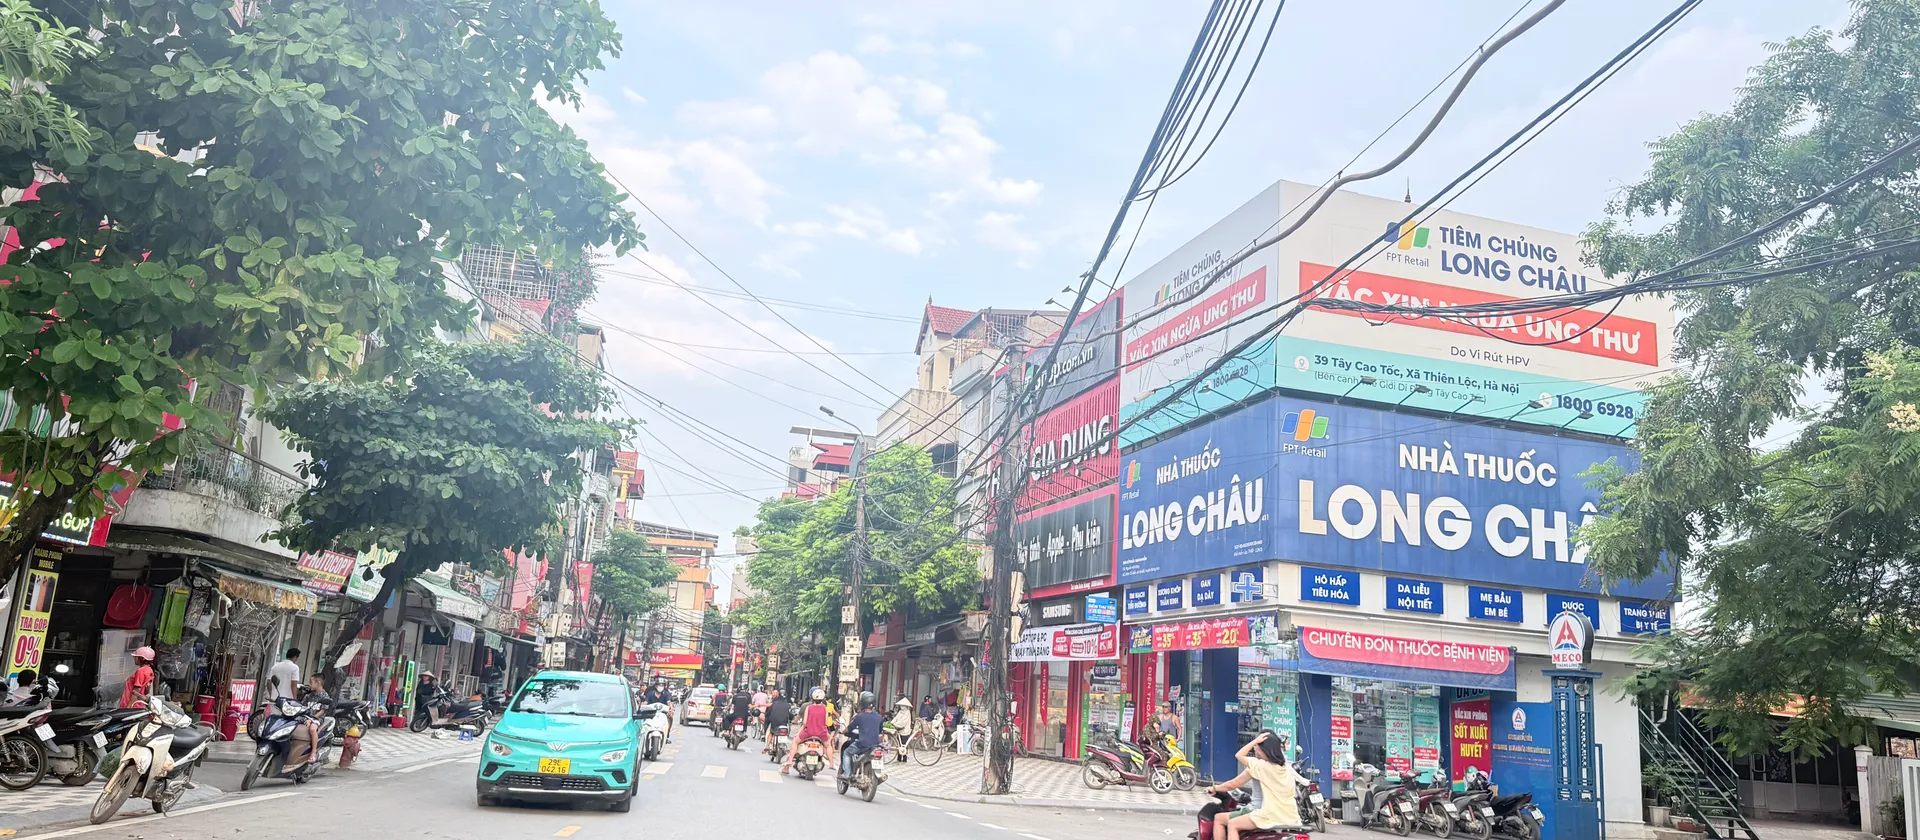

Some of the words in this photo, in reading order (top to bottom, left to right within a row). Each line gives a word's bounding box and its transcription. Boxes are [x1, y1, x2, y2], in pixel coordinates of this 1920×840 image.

[1439, 225, 1481, 249] TIÊM
[1487, 236, 1557, 263] CHỦNG
[1386, 252, 1402, 263] FPT
[1404, 255, 1429, 267] Retail
[1173, 270, 1190, 289] TIÊM
[1191, 250, 1221, 277] CHỦNG
[1441, 250, 1511, 281] LONG
[1518, 265, 1586, 294] CHÂU
[1151, 332, 1169, 352] XIN
[1170, 315, 1201, 343] NGỪA
[1203, 300, 1228, 327] UNG
[1230, 280, 1258, 311] THƯ
[1590, 327, 1641, 354] THƯ
[1450, 346, 1466, 357] Do
[1469, 348, 1480, 359] Vi
[1484, 351, 1503, 363] Rút
[1506, 355, 1530, 367] HPV
[1314, 355, 1329, 365] 39
[1332, 357, 1352, 371] Tây
[1355, 361, 1377, 373] Cao
[1379, 362, 1403, 379] Tốc,
[1406, 368, 1421, 379] Xã
[1424, 370, 1455, 384] Thiên
[1458, 375, 1480, 390] Lộc,
[1483, 379, 1498, 390] Hà
[1501, 383, 1520, 395] Nội
[1314, 371, 1334, 381] (Bên
[1336, 373, 1359, 385] cạnh
[1435, 388, 1449, 399] Tây
[1452, 391, 1467, 401] Cao
[1556, 394, 1592, 413] 1800
[1597, 402, 1634, 419] 6928
[1061, 415, 1112, 476] DỤNG
[1283, 443, 1299, 455] FPT
[1301, 445, 1327, 458] Retail
[1156, 455, 1179, 485] NHÀ
[1181, 437, 1220, 477] THUỐC
[1399, 440, 1460, 476] NHÀ
[1464, 448, 1557, 487] THUỐC
[1121, 492, 1129, 501] FPT
[1129, 489, 1139, 499] Retail
[1122, 501, 1183, 550] LONG
[1187, 474, 1263, 536] CHÂU
[1298, 479, 1472, 551] LONG
[1046, 529, 1065, 563] Apple
[1071, 523, 1084, 558] Phụ
[1086, 519, 1100, 554] kiện
[39, 560, 55, 569] MOBILE
[1200, 579, 1211, 588] GAN
[1315, 575, 1327, 585] HÔ
[1329, 575, 1347, 586] HẤP
[1170, 585, 1182, 594] KHỚP
[1312, 587, 1328, 598] TIÊU
[1331, 588, 1349, 600] HÓA
[1398, 584, 1412, 594] DA
[1415, 583, 1430, 595] LIỄU
[1398, 599, 1414, 609] NỘI
[1416, 598, 1433, 609] TIẾT
[1480, 593, 1493, 603] MẸ
[1495, 590, 1511, 604] BẦU
[1042, 603, 1072, 619] SAMSUNG
[1485, 607, 1496, 616] EM
[1498, 607, 1508, 618] BÉ
[1562, 601, 1584, 611] DƯỢC
[1624, 607, 1648, 618] TRANG
[1636, 621, 1643, 631] BỊ
[1650, 621, 1659, 631] TẾ
[1040, 632, 1047, 641] PC
[14, 635, 41, 668] 0%
[1036, 644, 1050, 656] BẢNG
[1084, 638, 1098, 654] 10%
[1309, 631, 1361, 649] CHUYÊN
[1364, 636, 1393, 652] ĐƠN
[1396, 638, 1440, 656] THUỐC
[1444, 642, 1475, 663] BỆNH
[1477, 648, 1504, 666] VIỆN
[1553, 653, 1582, 662] MECO
[232, 684, 254, 700] PHOTO
[1277, 706, 1290, 715] TIÊM
[1454, 707, 1463, 719] VẮC
[1463, 710, 1472, 720] XIN
[1472, 710, 1488, 720] PHÒNG
[1274, 715, 1293, 726] CHỦNG
[1274, 728, 1292, 737] LONG
[1454, 722, 1468, 738] SỐT
[1470, 723, 1488, 740] XUẤT
[1460, 741, 1482, 758] HUYẾT
